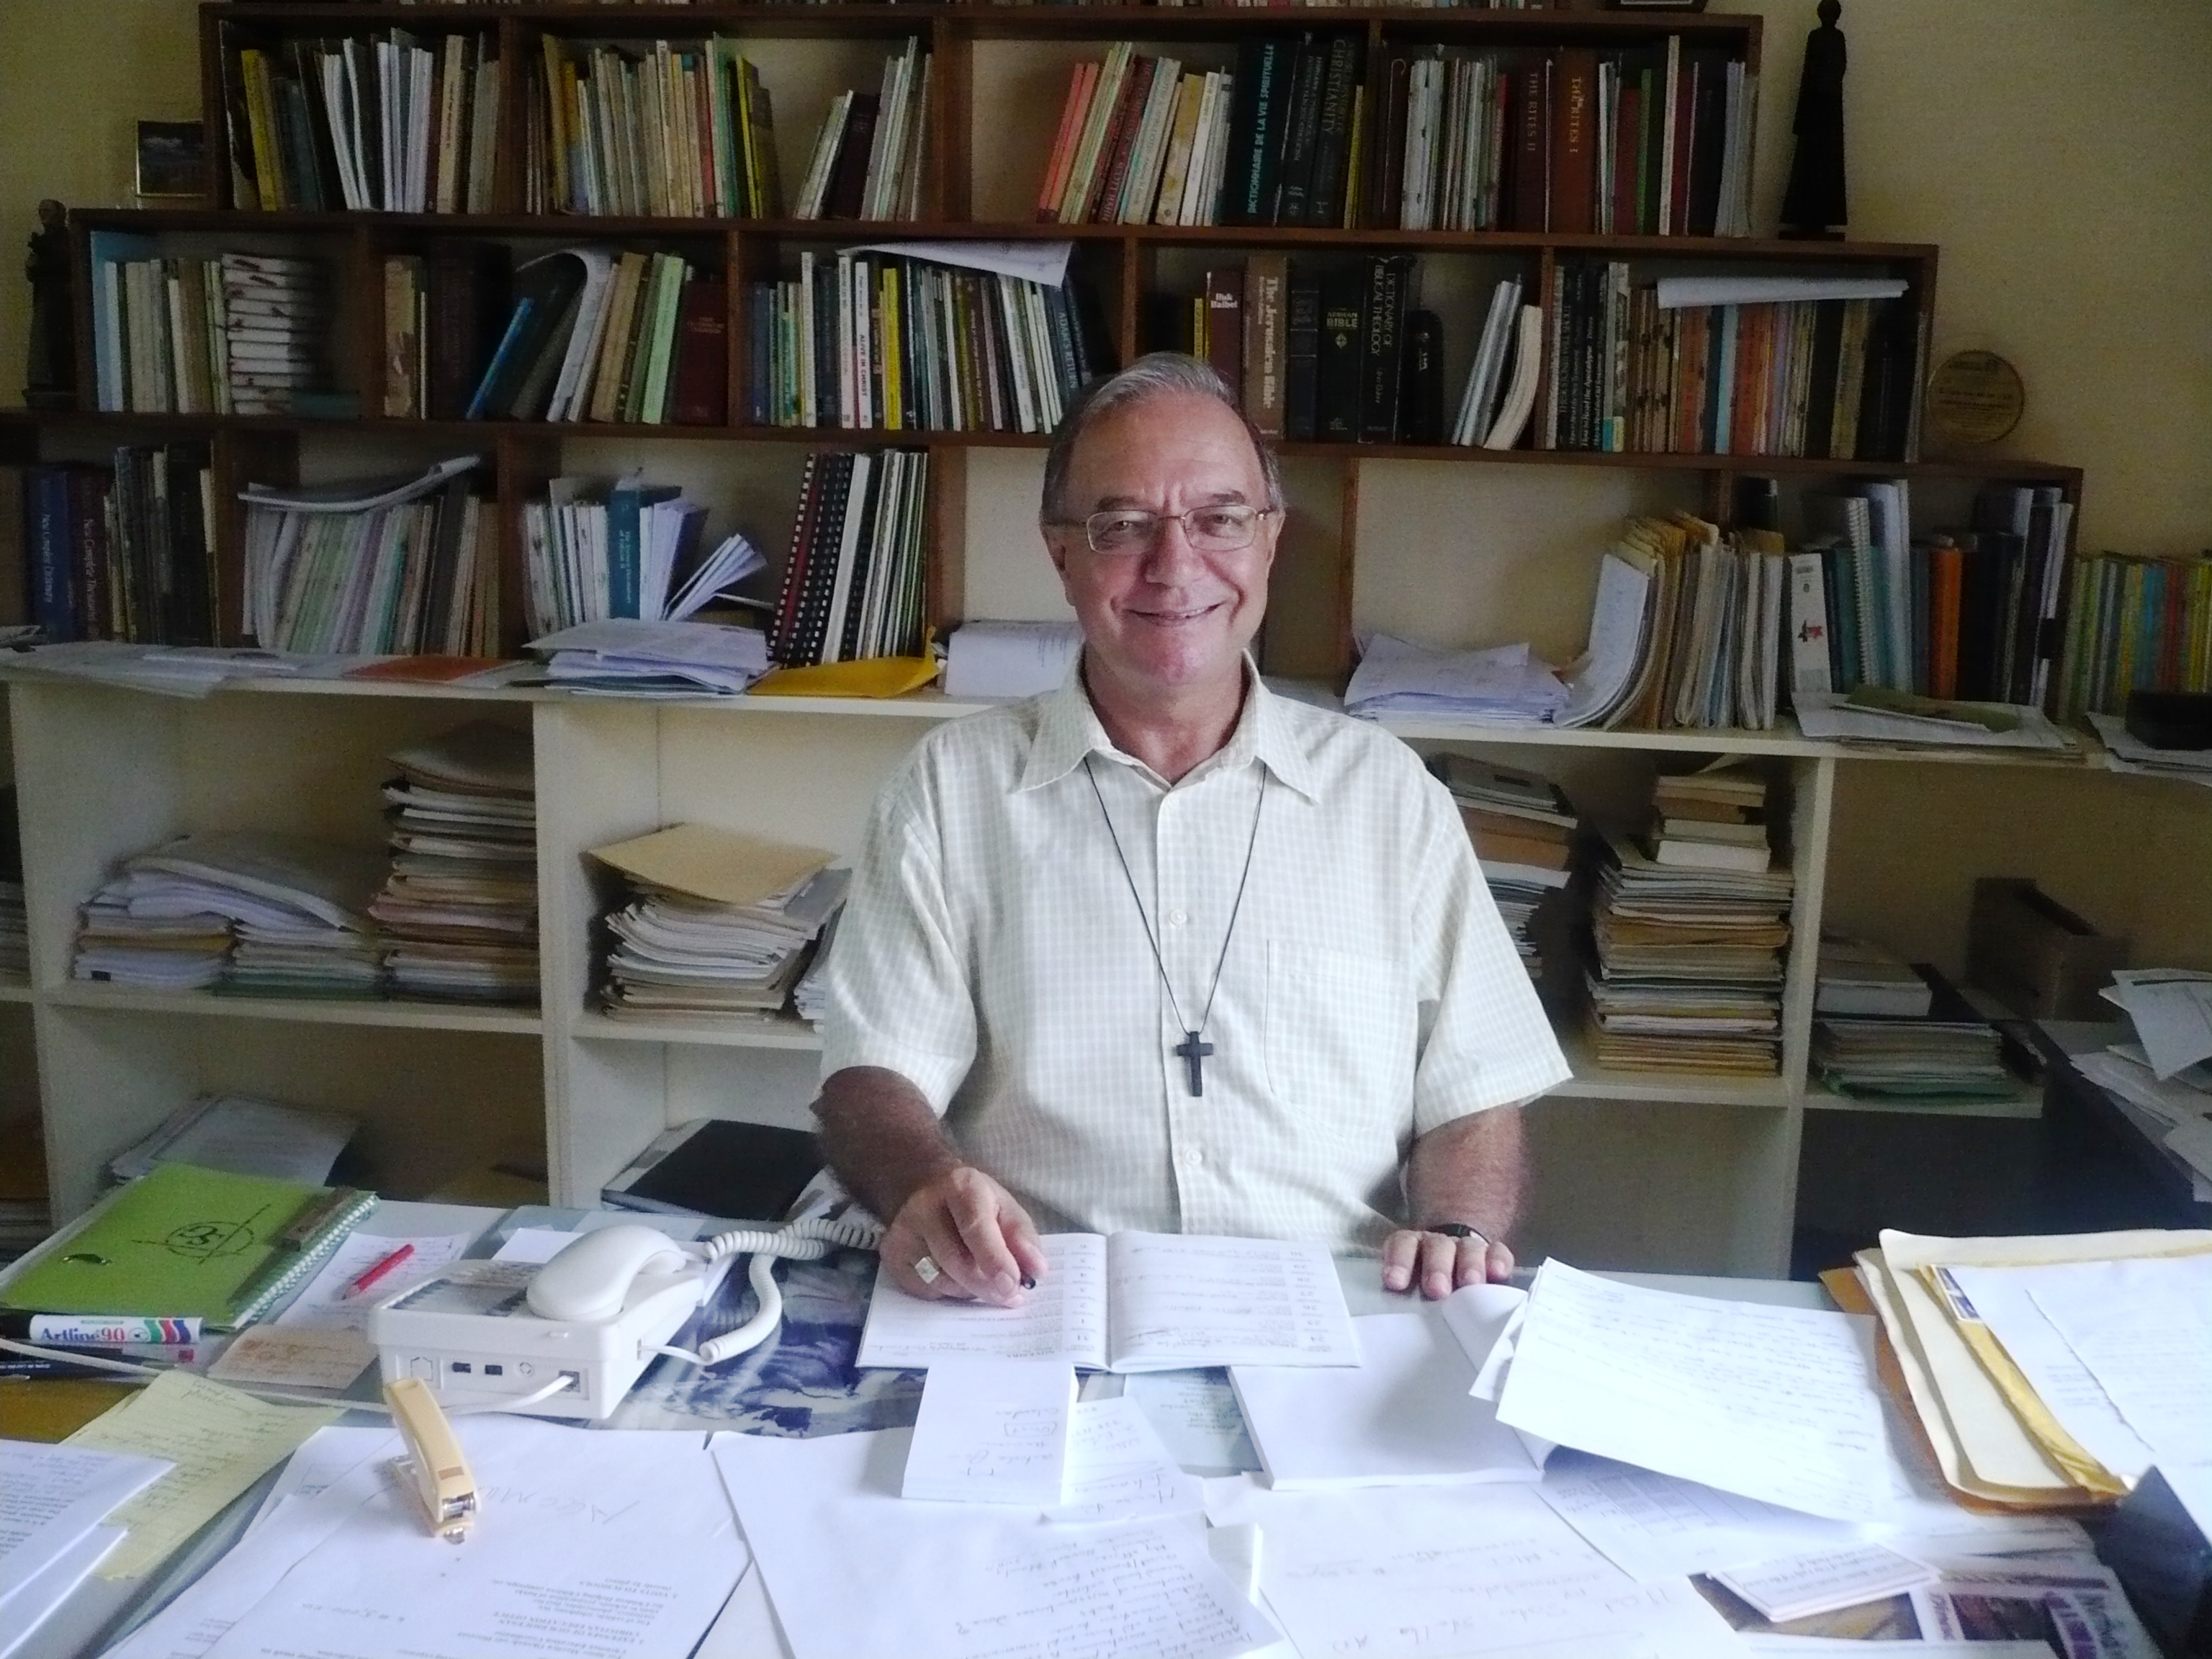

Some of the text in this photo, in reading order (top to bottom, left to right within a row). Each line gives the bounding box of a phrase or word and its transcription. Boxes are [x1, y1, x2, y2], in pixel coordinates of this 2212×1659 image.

[1321, 39, 1346, 135] CHRISTIANITY
[1528, 73, 1538, 96] THE
[1570, 76, 1582, 102] THE
[1246, 43, 1274, 214] DICTIONNAIRE DE LA VIE SPIRITUELLE
[1527, 101, 1538, 137] RITES
[1570, 107, 1581, 143] RITES
[1326, 318, 1359, 329] BIBLE
[1371, 264, 1385, 356] BIBLICAL THEOLOGY
[1382, 273, 1397, 347] DICTIONARY OF
[1058, 311, 1080, 390] ADAM'S RETURN
[1263, 276, 1279, 409] The Jerusalem Bible
[860, 359, 868, 368] IN
[1583, 345, 1593, 387] Apocalypse
[40, 513, 53, 531] New
[84, 518, 96, 536] New
[84, 538, 97, 577] Complete
[42, 565, 57, 603] Dictionary
[41, 1326, 126, 1343] Artline 90
